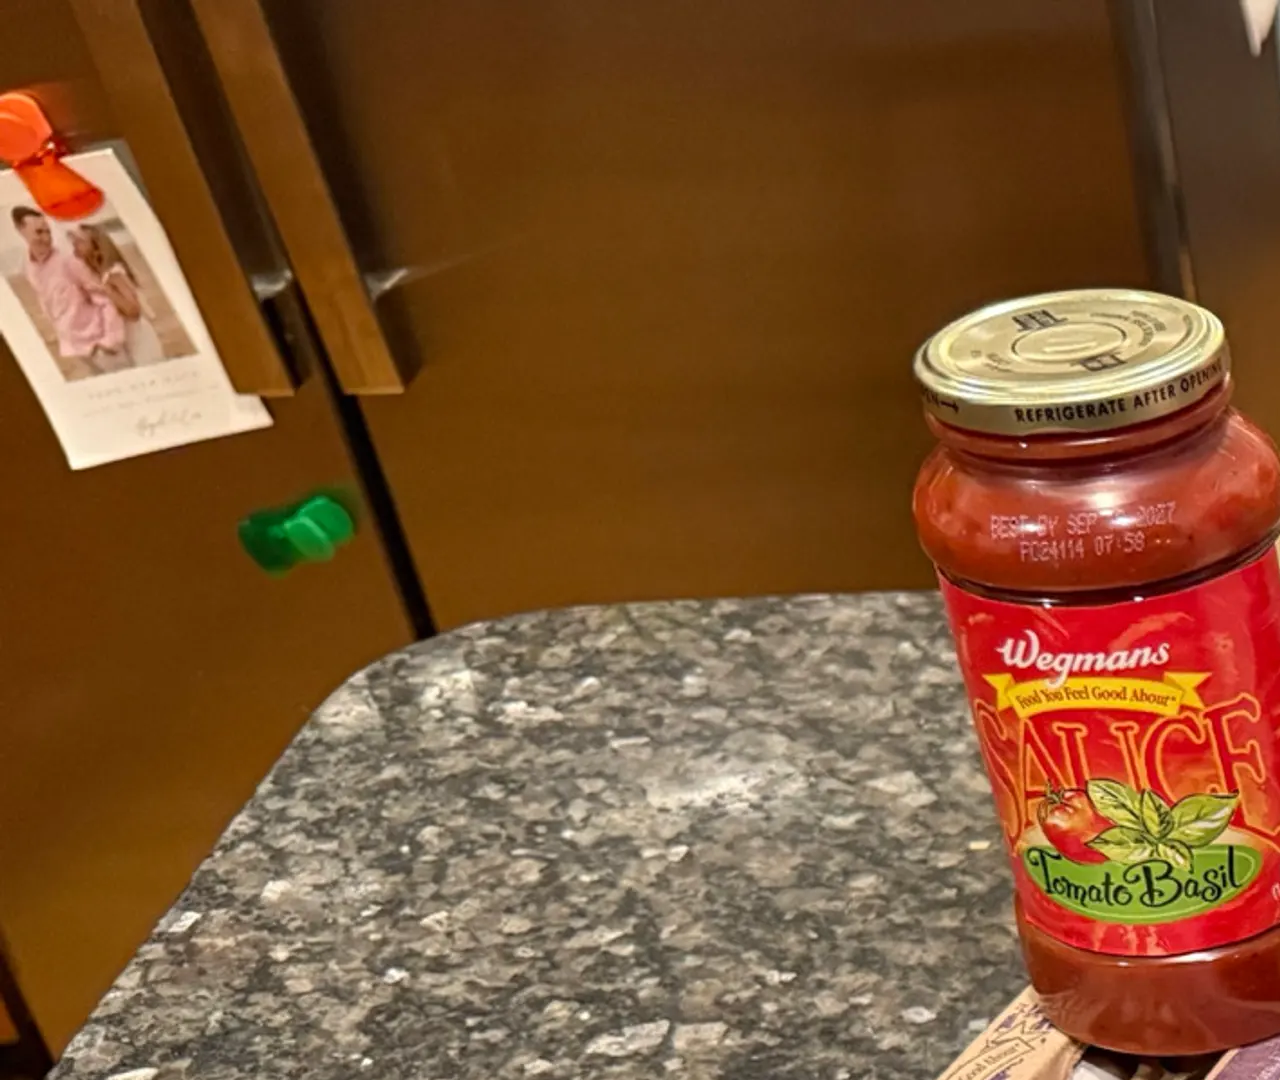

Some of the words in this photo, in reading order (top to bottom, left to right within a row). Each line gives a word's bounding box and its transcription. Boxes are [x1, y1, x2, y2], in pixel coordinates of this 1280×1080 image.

[1014, 397, 1127, 423] REFRIGERATE
[1133, 381, 1177, 410] AFTER
[1180, 356, 1223, 393] OPENING
[990, 514, 1029, 540] BEST
[1038, 514, 1060, 537] BY
[1067, 512, 1098, 535] SEP
[996, 629, 1171, 690] Wegmans
[1015, 690, 1040, 709] Food
[1040, 687, 1064, 702] You
[1065, 686, 1090, 701] Feel
[1092, 686, 1128, 701] Good
[1027, 847, 1133, 907] Tomato
[1123, 845, 1244, 909] Basil
